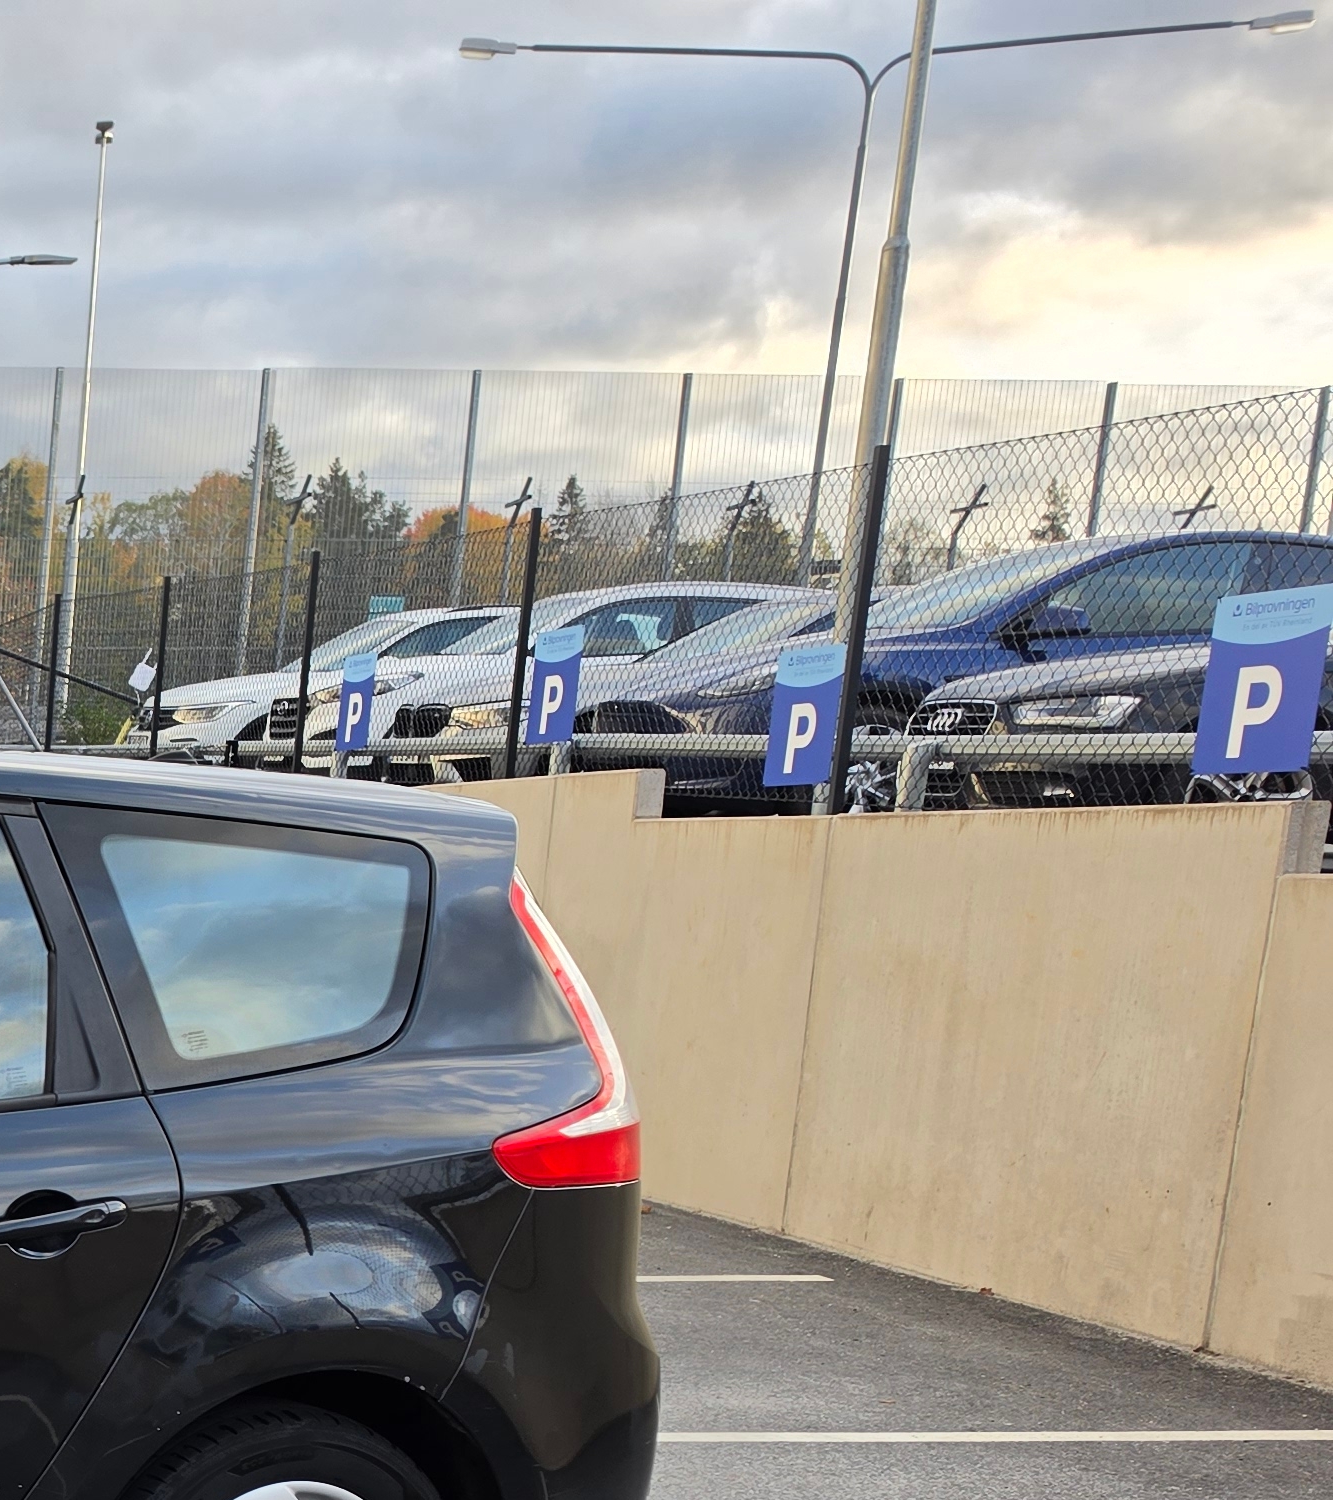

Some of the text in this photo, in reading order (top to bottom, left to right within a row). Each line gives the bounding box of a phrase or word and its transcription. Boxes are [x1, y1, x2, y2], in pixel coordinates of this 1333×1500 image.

[1245, 597, 1315, 617] Bilprovningen
[344, 692, 363, 743] P
[538, 674, 564, 735] P
[1225, 664, 1283, 759] P
[782, 702, 817, 774] P
